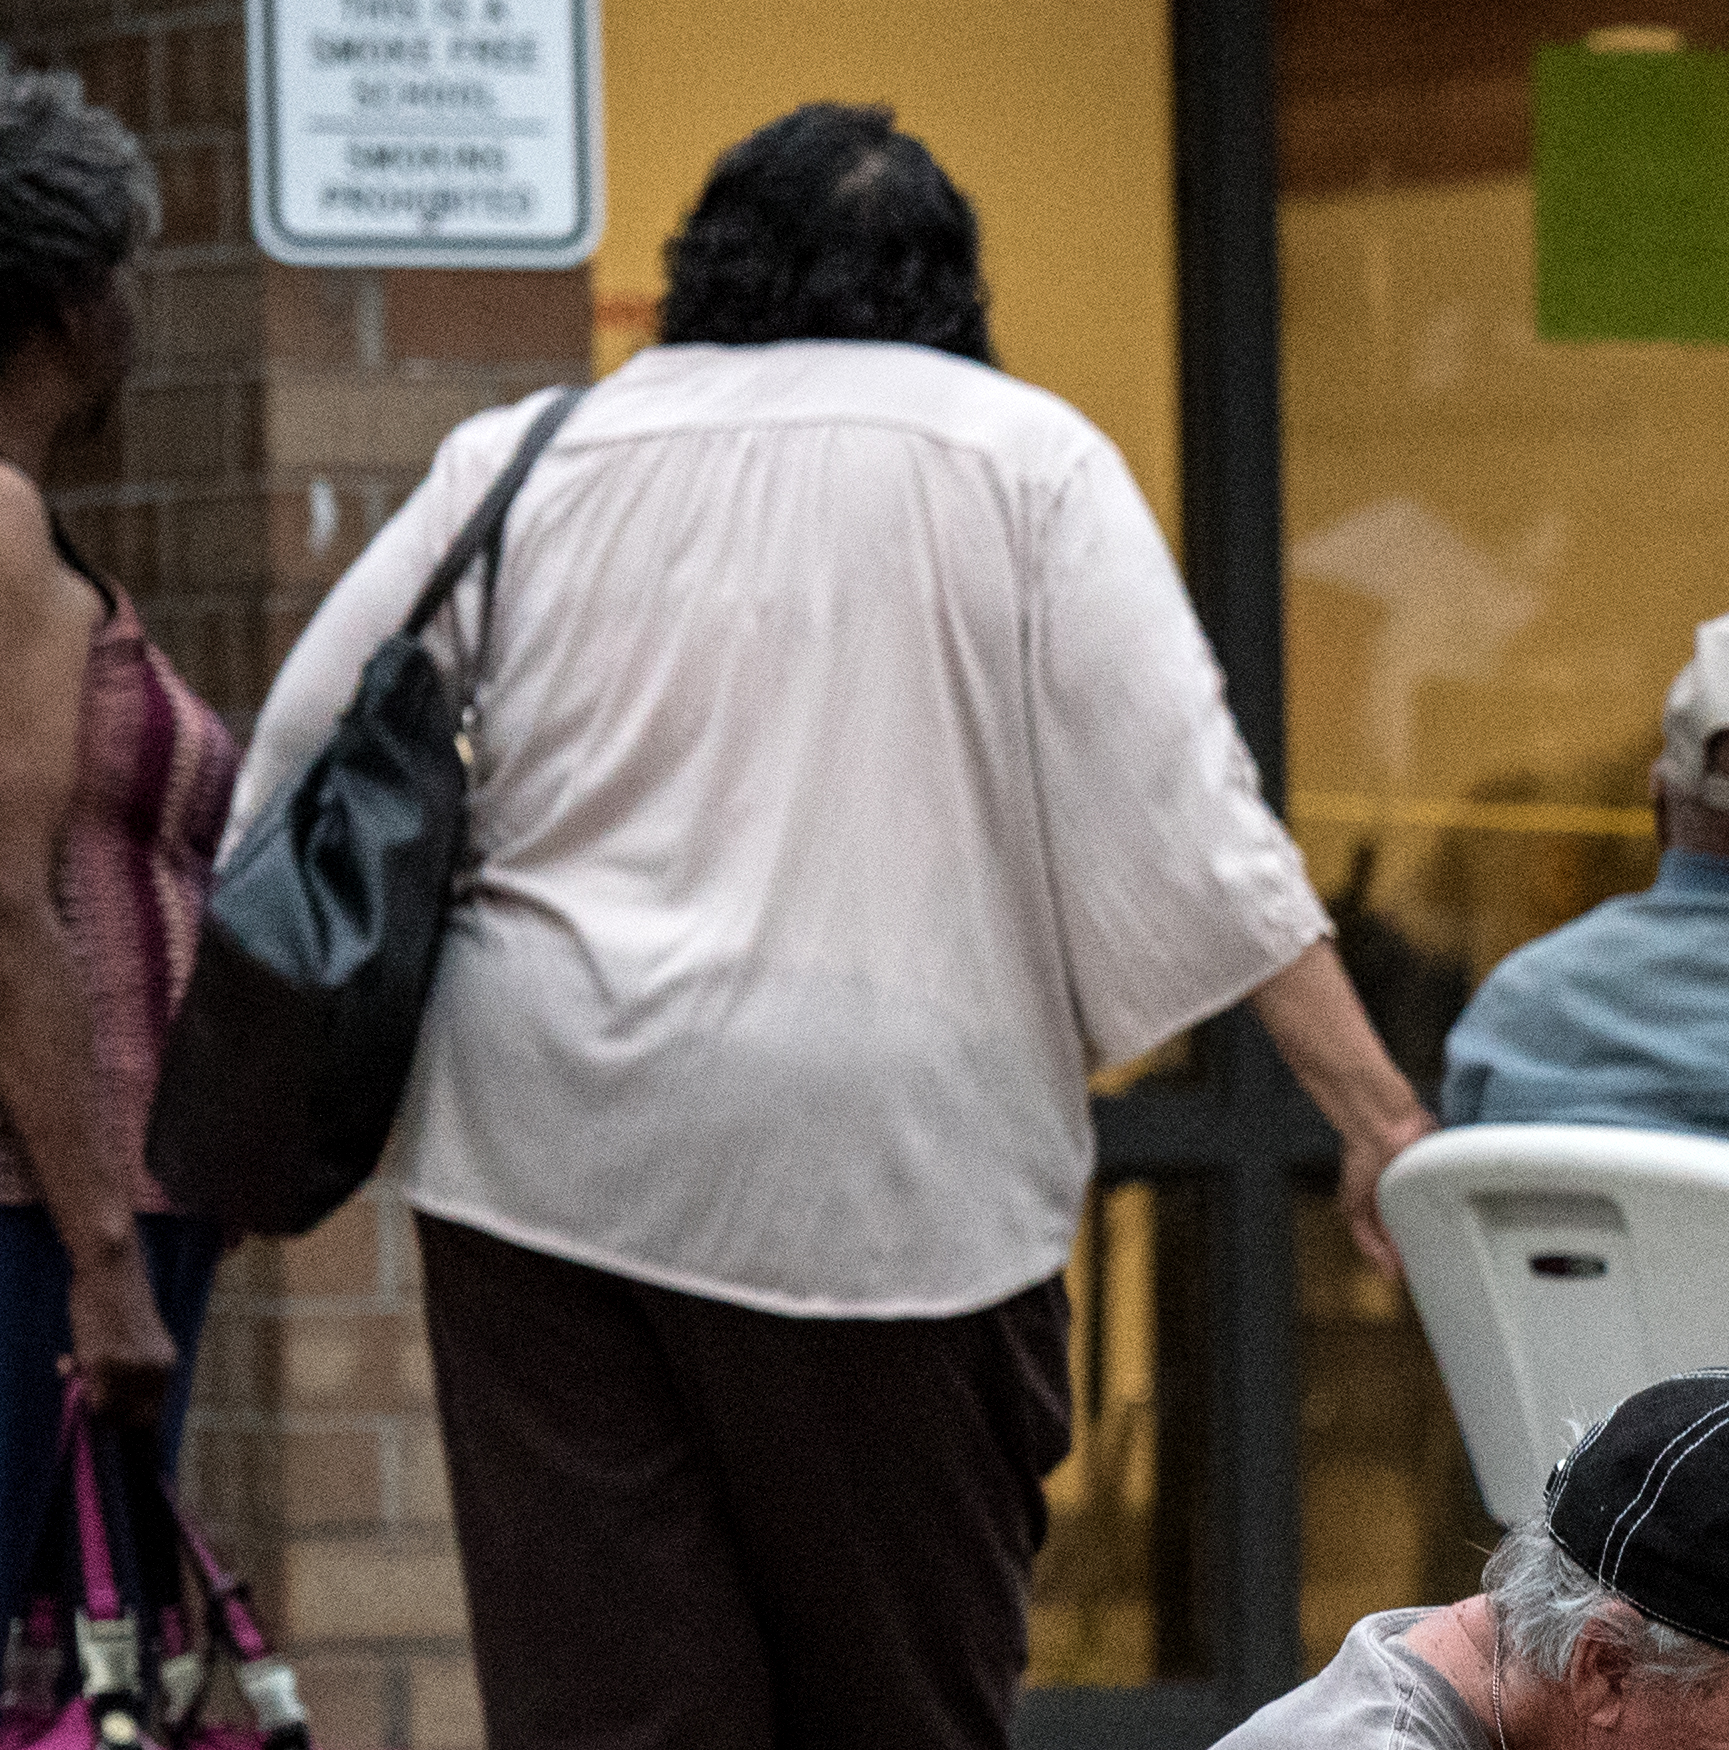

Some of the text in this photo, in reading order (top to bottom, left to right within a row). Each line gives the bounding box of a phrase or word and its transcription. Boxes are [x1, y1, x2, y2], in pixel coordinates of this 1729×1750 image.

[311, 36, 537, 68] SMOKE FREE
[354, 80, 497, 108] SCHOOL
[347, 145, 507, 171] SMOKING
[321, 187, 533, 214] PROHIBITED
